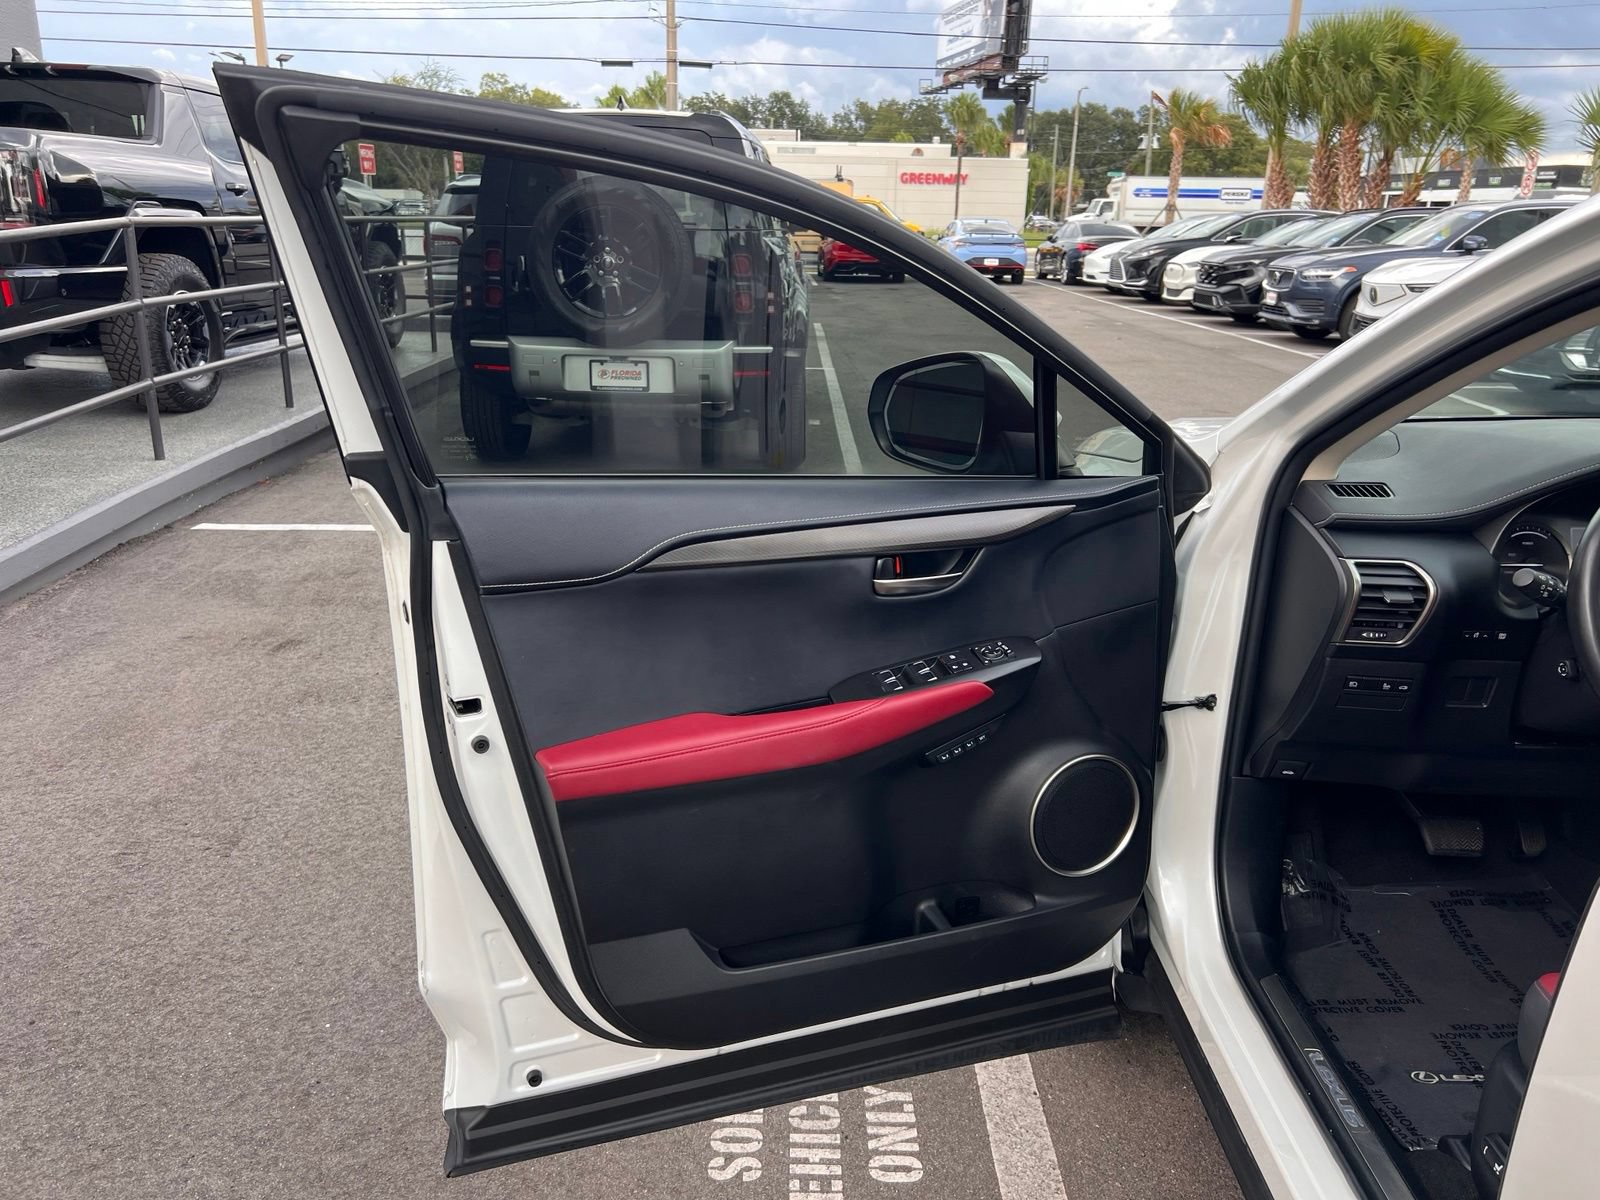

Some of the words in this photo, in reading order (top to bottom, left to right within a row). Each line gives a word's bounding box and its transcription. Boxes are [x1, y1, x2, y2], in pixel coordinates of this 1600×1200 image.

[900, 172, 968, 185] GREENWAY
[1308, 1051, 1364, 1128] LEXUS
[863, 1085, 924, 1183] ONLY
